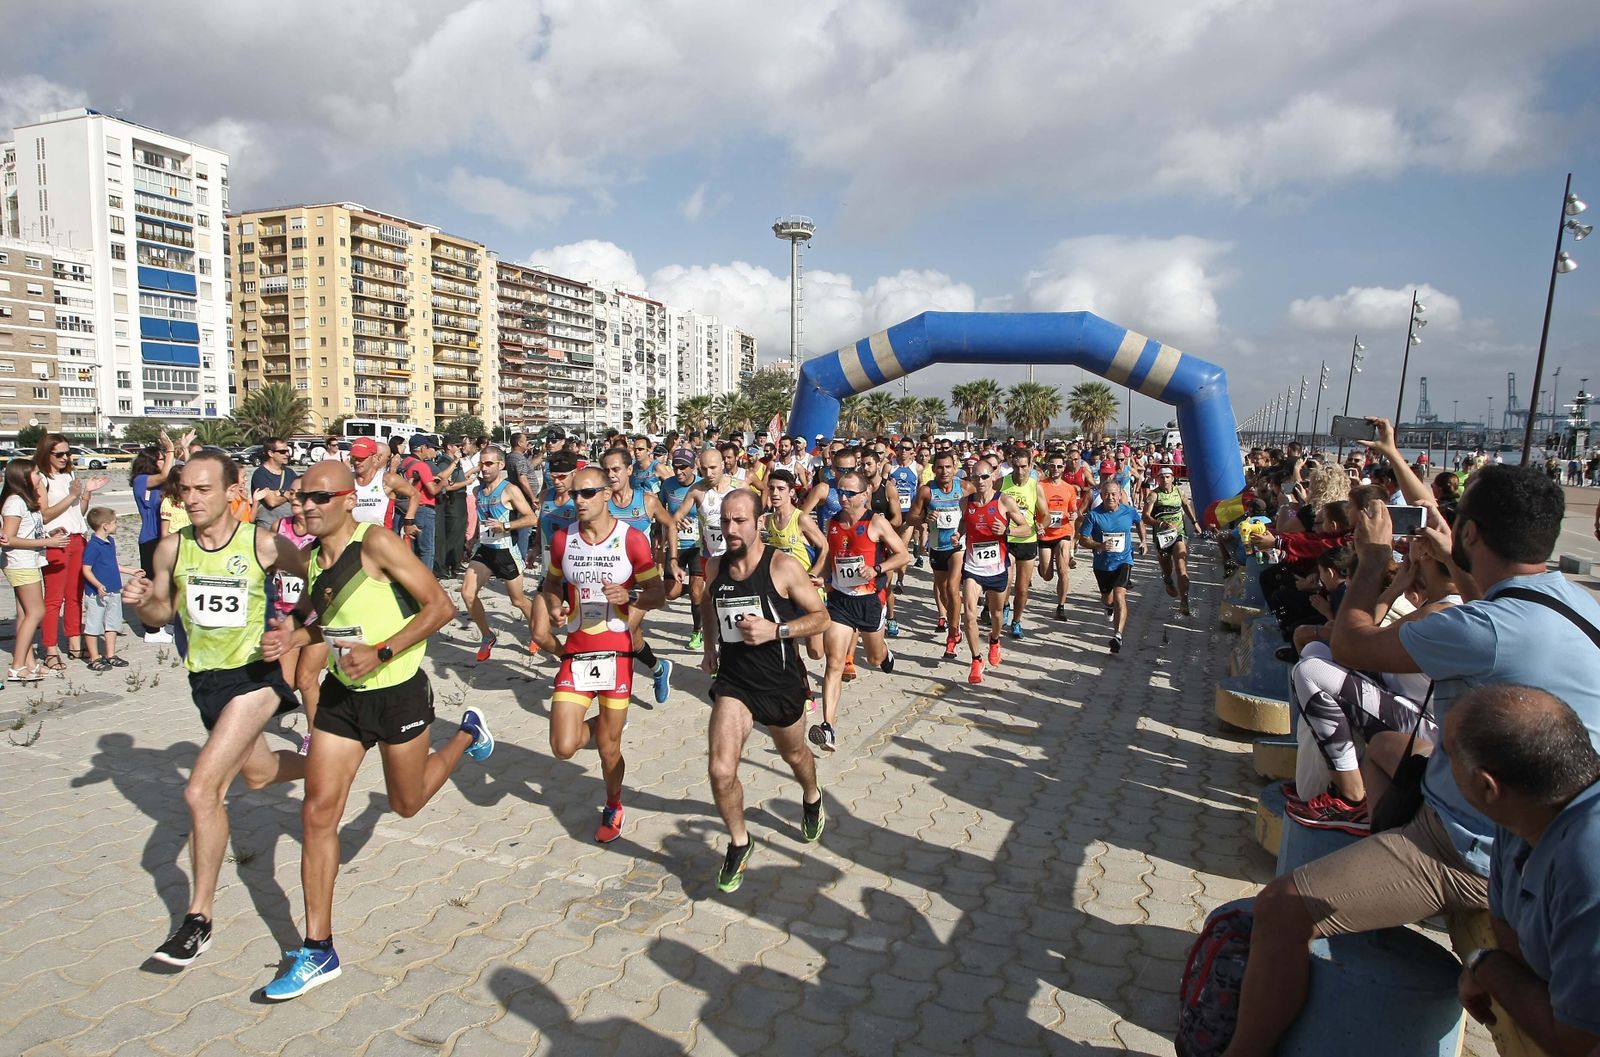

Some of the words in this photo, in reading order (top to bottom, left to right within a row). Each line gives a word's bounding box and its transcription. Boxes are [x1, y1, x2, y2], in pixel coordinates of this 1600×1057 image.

[1164, 535, 1174, 543] 39
[977, 549, 997, 560] 128
[572, 571, 612, 584] MORALES
[285, 582, 300, 594] 14
[194, 594, 240, 613] 153
[724, 613, 757, 630] 18
[589, 665, 601, 678] 4
